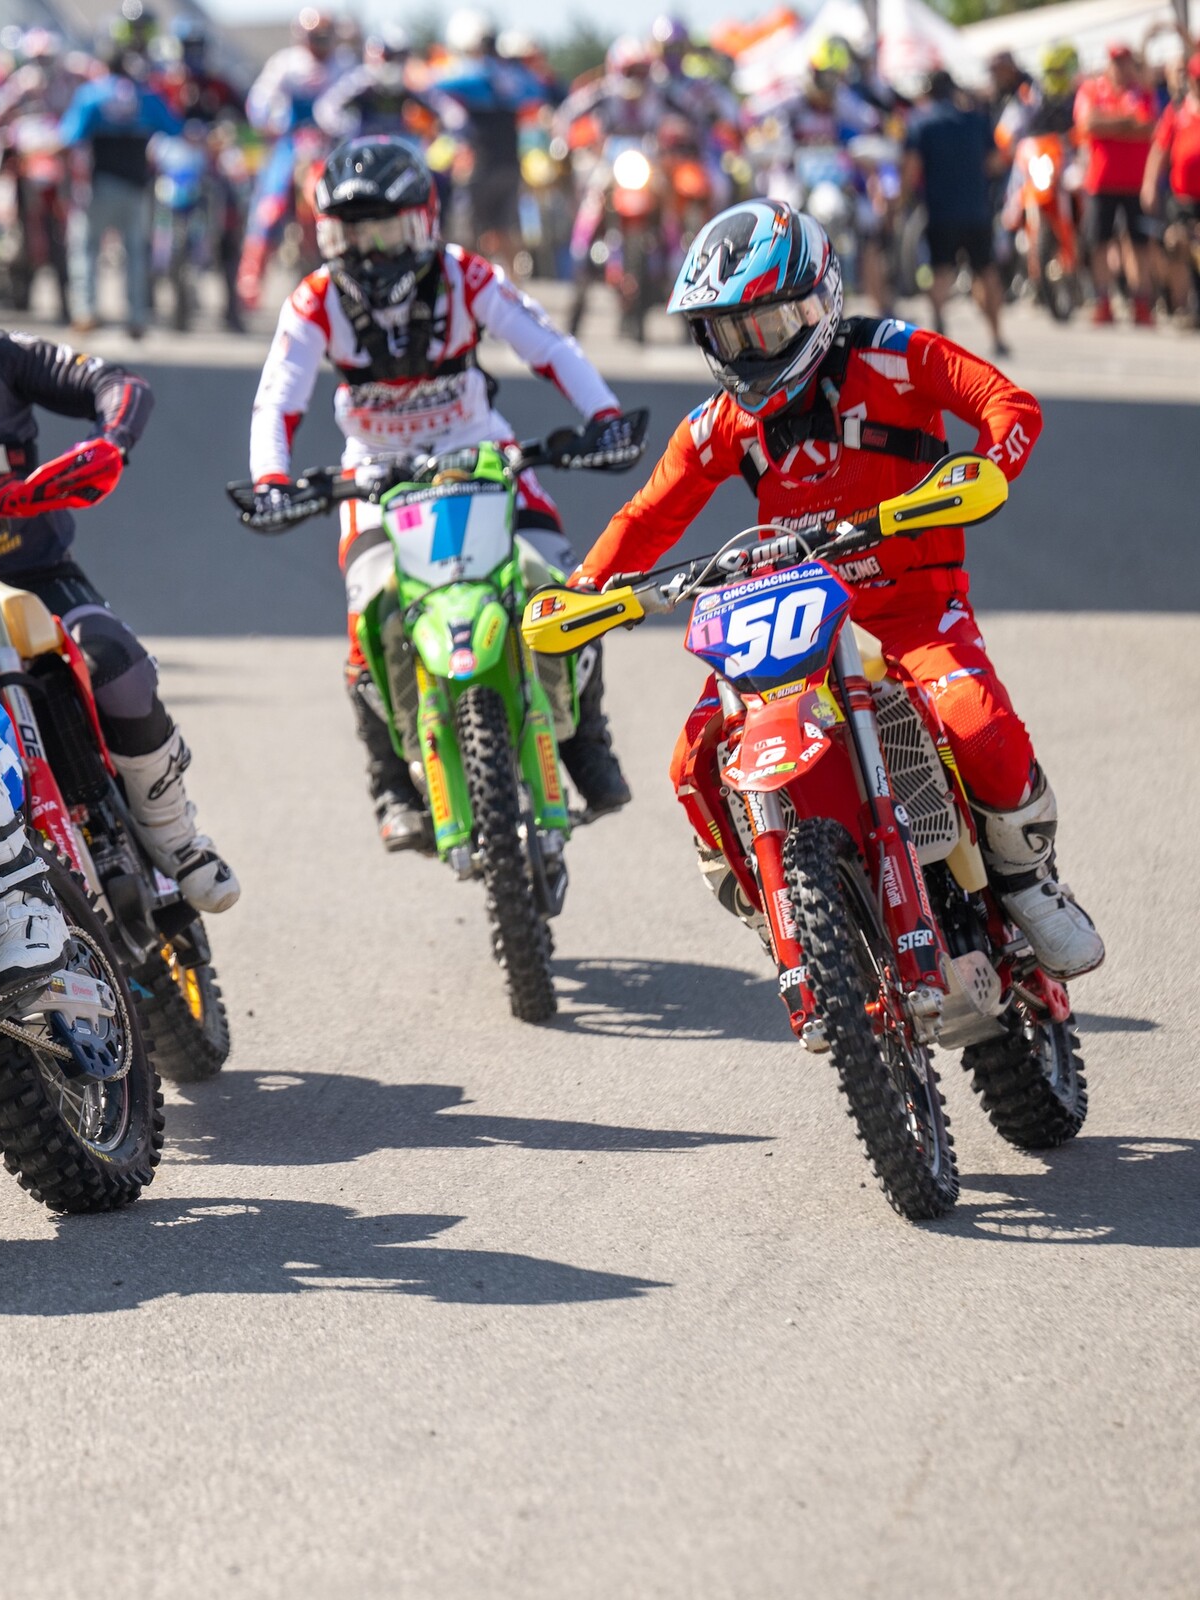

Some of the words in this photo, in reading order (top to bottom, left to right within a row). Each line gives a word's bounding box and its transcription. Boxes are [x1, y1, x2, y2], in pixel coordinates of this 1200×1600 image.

[430, 495, 473, 564] 1
[722, 567, 824, 601] GNCCRACING.COM
[693, 604, 735, 626] TURNER
[700, 625, 710, 646] 1
[724, 587, 828, 678] 50
